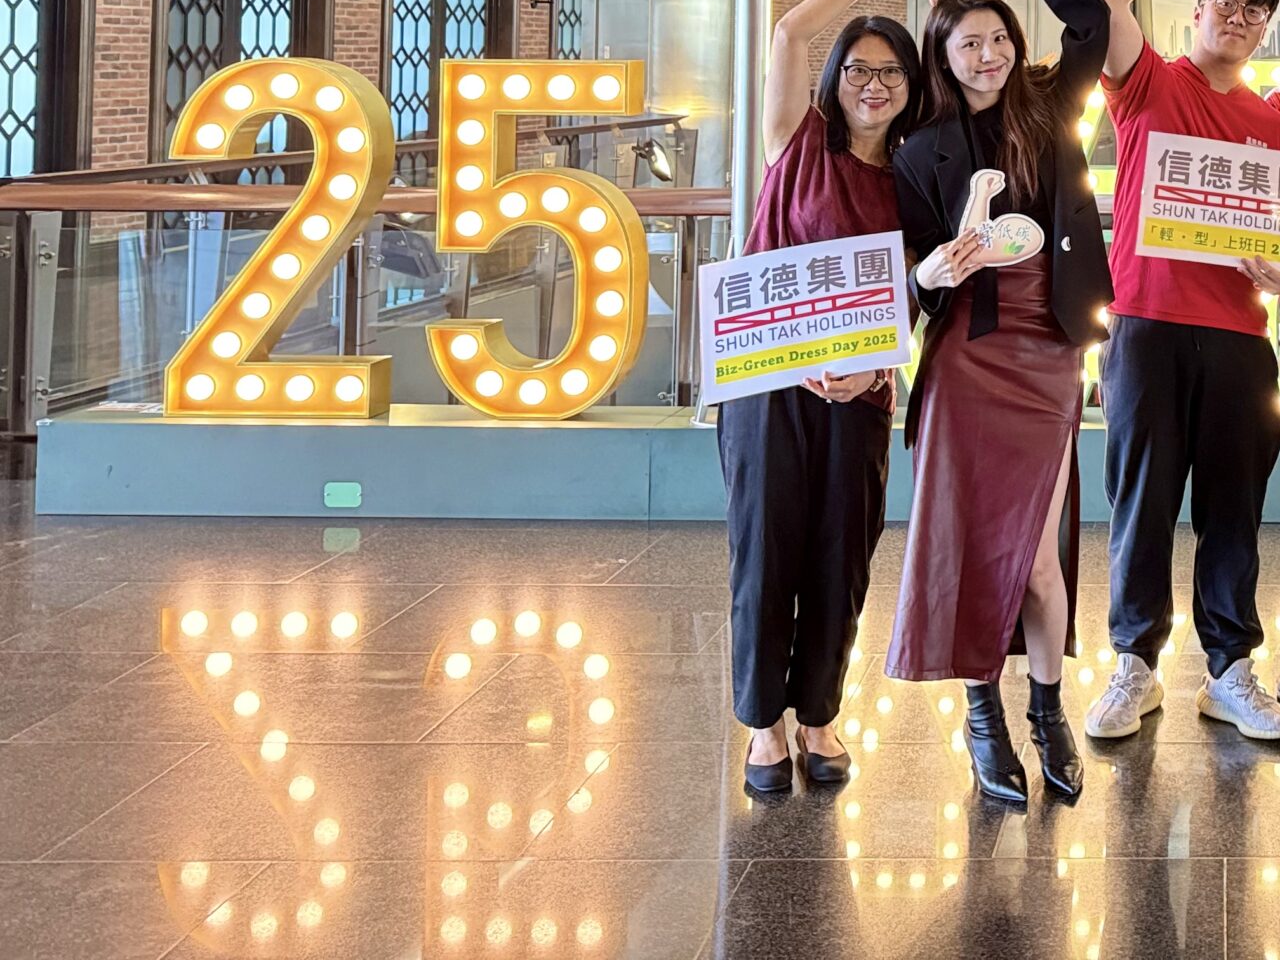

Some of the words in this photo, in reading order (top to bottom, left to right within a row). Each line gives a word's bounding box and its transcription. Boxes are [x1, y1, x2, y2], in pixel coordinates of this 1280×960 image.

[1152, 202, 1196, 218] SHUN
[1200, 208, 1229, 225] TAK
[164, 58, 650, 420] 25
[713, 247, 894, 315] 信德集團
[714, 329, 763, 354] SHUN
[768, 323, 802, 341] TAK
[807, 306, 896, 333] HOLDINGS
[715, 354, 785, 378] Biz-Green
[789, 347, 828, 361] Dress
[832, 339, 860, 354] Day
[864, 332, 897, 347] 2025
